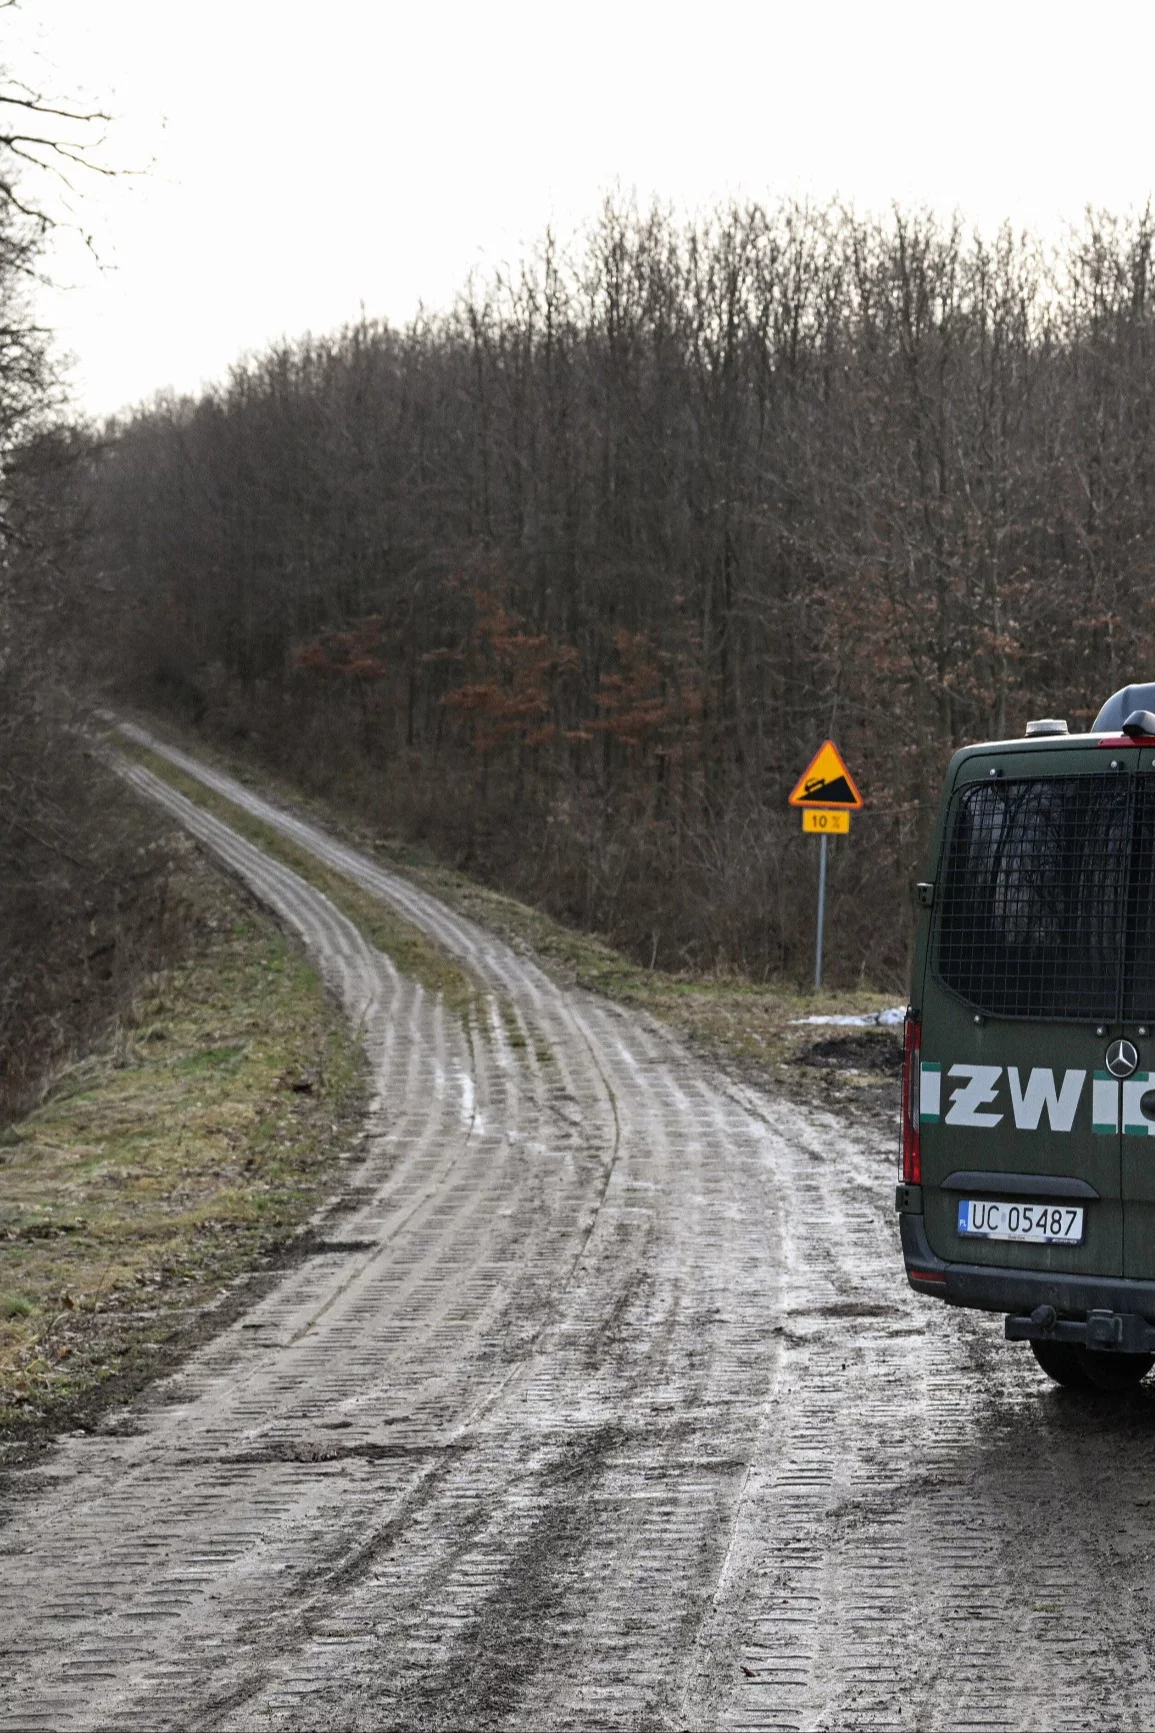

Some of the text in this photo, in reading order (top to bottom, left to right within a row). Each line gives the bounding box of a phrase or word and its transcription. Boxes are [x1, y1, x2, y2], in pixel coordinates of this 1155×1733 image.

[812, 814, 827, 829] 10
[972, 1203, 1077, 1237] UC 05487
